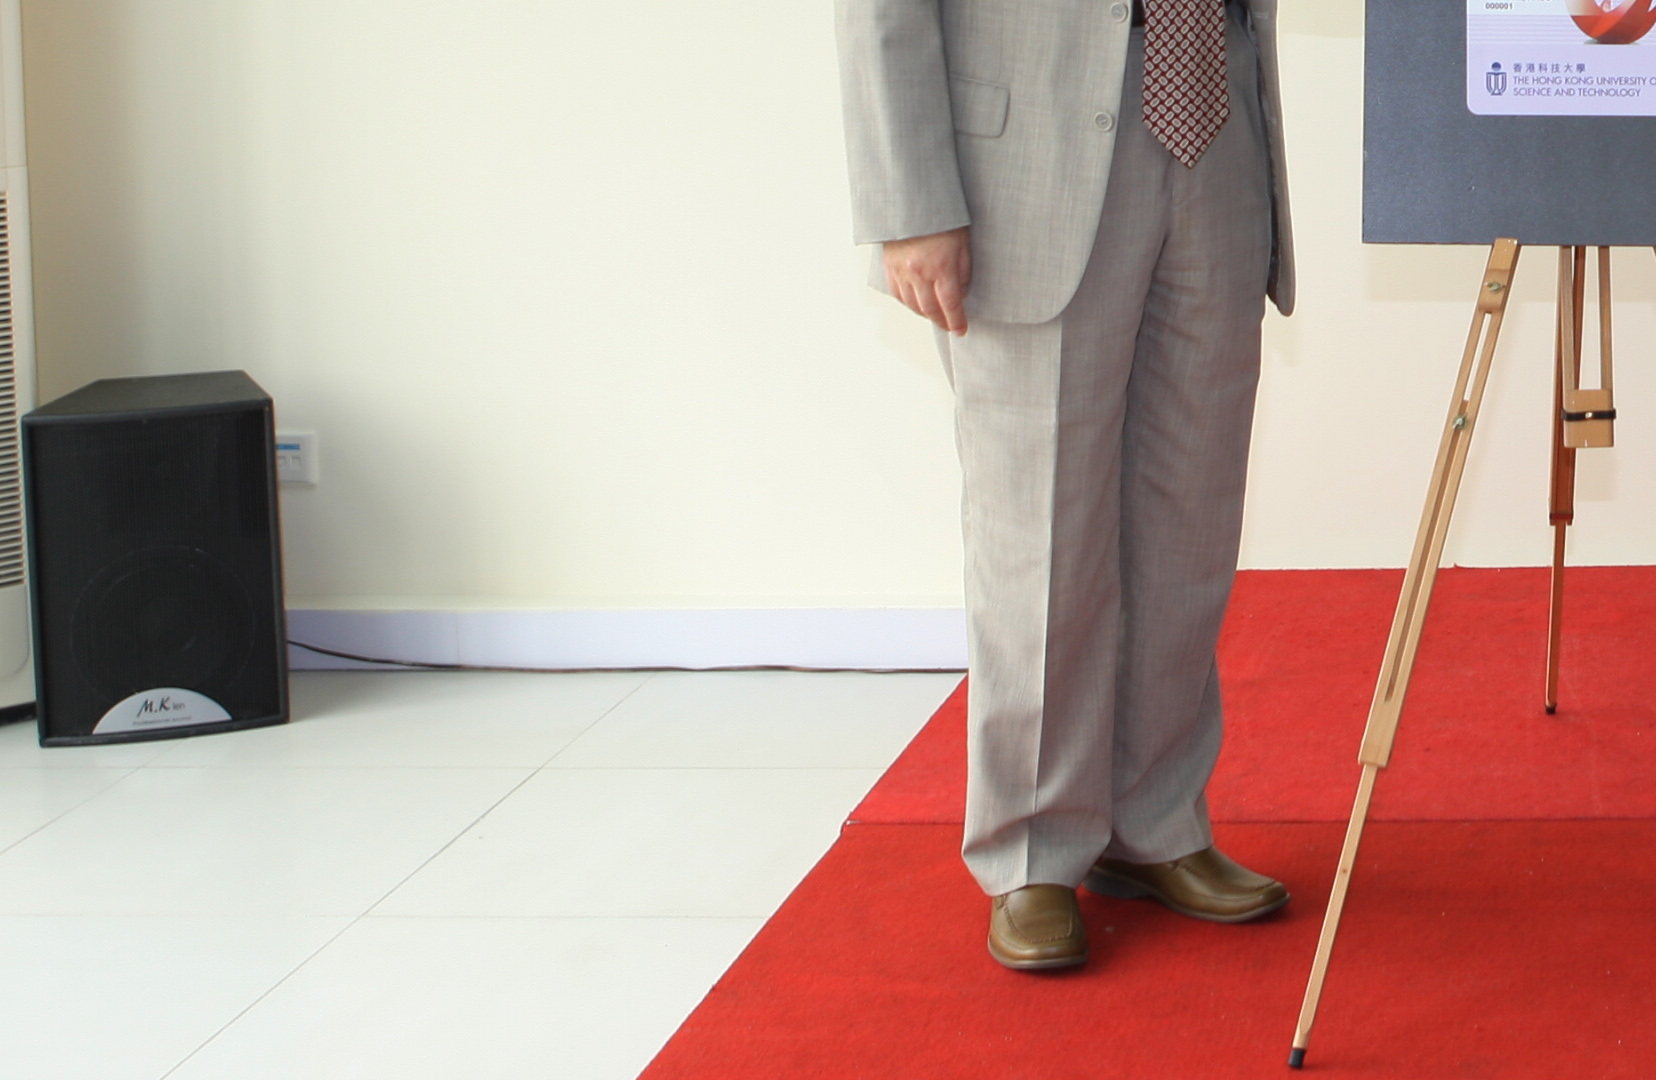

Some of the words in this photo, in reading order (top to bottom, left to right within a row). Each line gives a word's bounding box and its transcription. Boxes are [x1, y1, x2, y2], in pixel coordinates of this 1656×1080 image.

[1513, 63, 1586, 74] 香港科技大學
[1513, 76, 1529, 85] THE
[1532, 76, 1562, 86] HONG
[1565, 76, 1594, 86] KONG
[1596, 76, 1647, 86] UNIVERSITY
[1513, 87, 1551, 97] SCIENCE
[1554, 87, 1576, 97] AND
[1578, 87, 1641, 97] TECHNOLOGY
